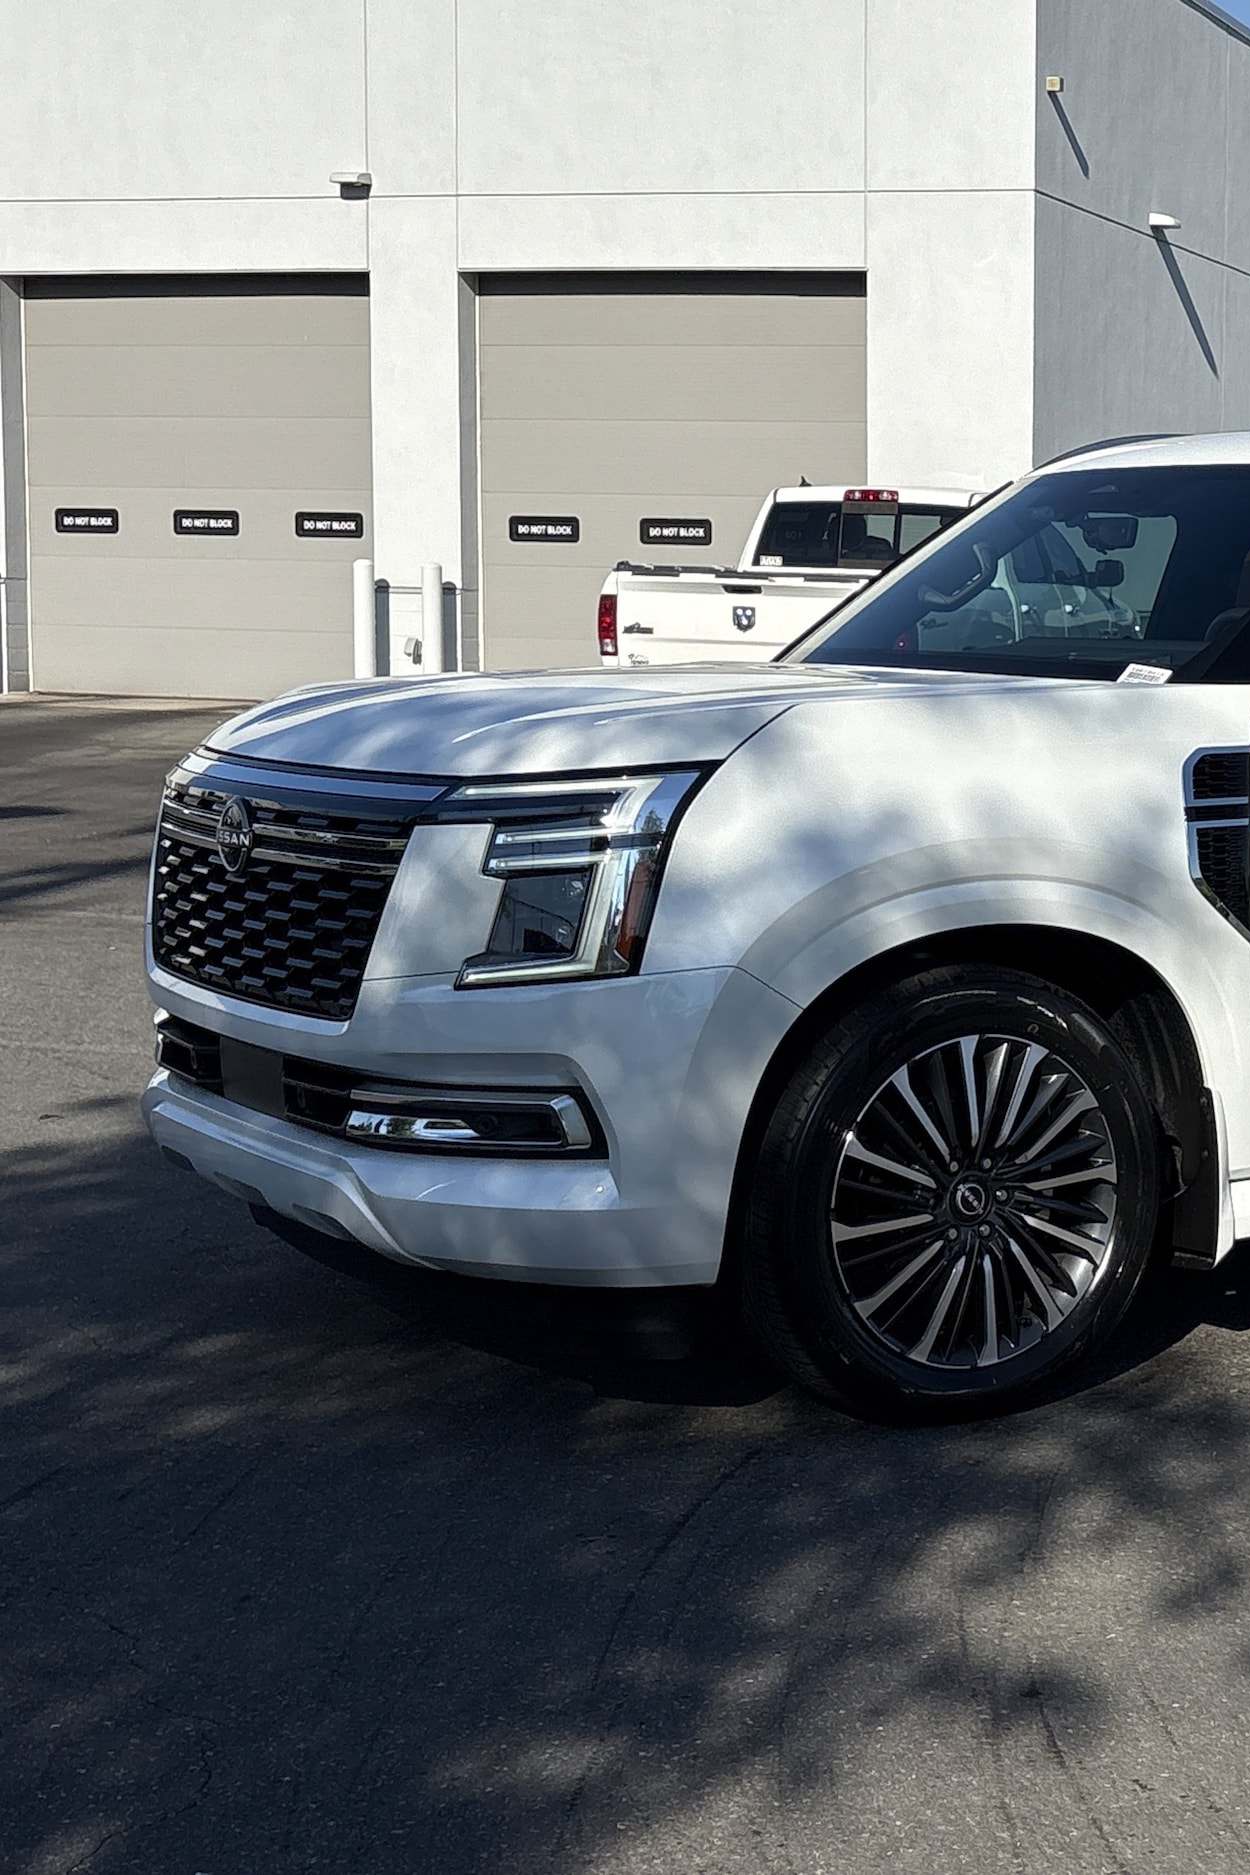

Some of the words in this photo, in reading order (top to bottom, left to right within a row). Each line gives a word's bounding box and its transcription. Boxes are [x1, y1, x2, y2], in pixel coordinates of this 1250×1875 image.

[64, 517, 74, 525] DO
[75, 517, 89, 525] NOT
[90, 517, 112, 525] BLOCK
[182, 518, 193, 527] DO
[194, 519, 208, 527] NOT
[209, 519, 232, 528] BLOCK
[304, 521, 315, 529] DO
[316, 521, 331, 529] NOT
[332, 521, 356, 530] BLOCK
[518, 525, 530, 533] DO
[530, 525, 546, 534] NOT
[547, 526, 572, 534] BLOCK
[649, 527, 661, 536] DO
[662, 527, 678, 536] NOT
[679, 528, 704, 537] BLOCK
